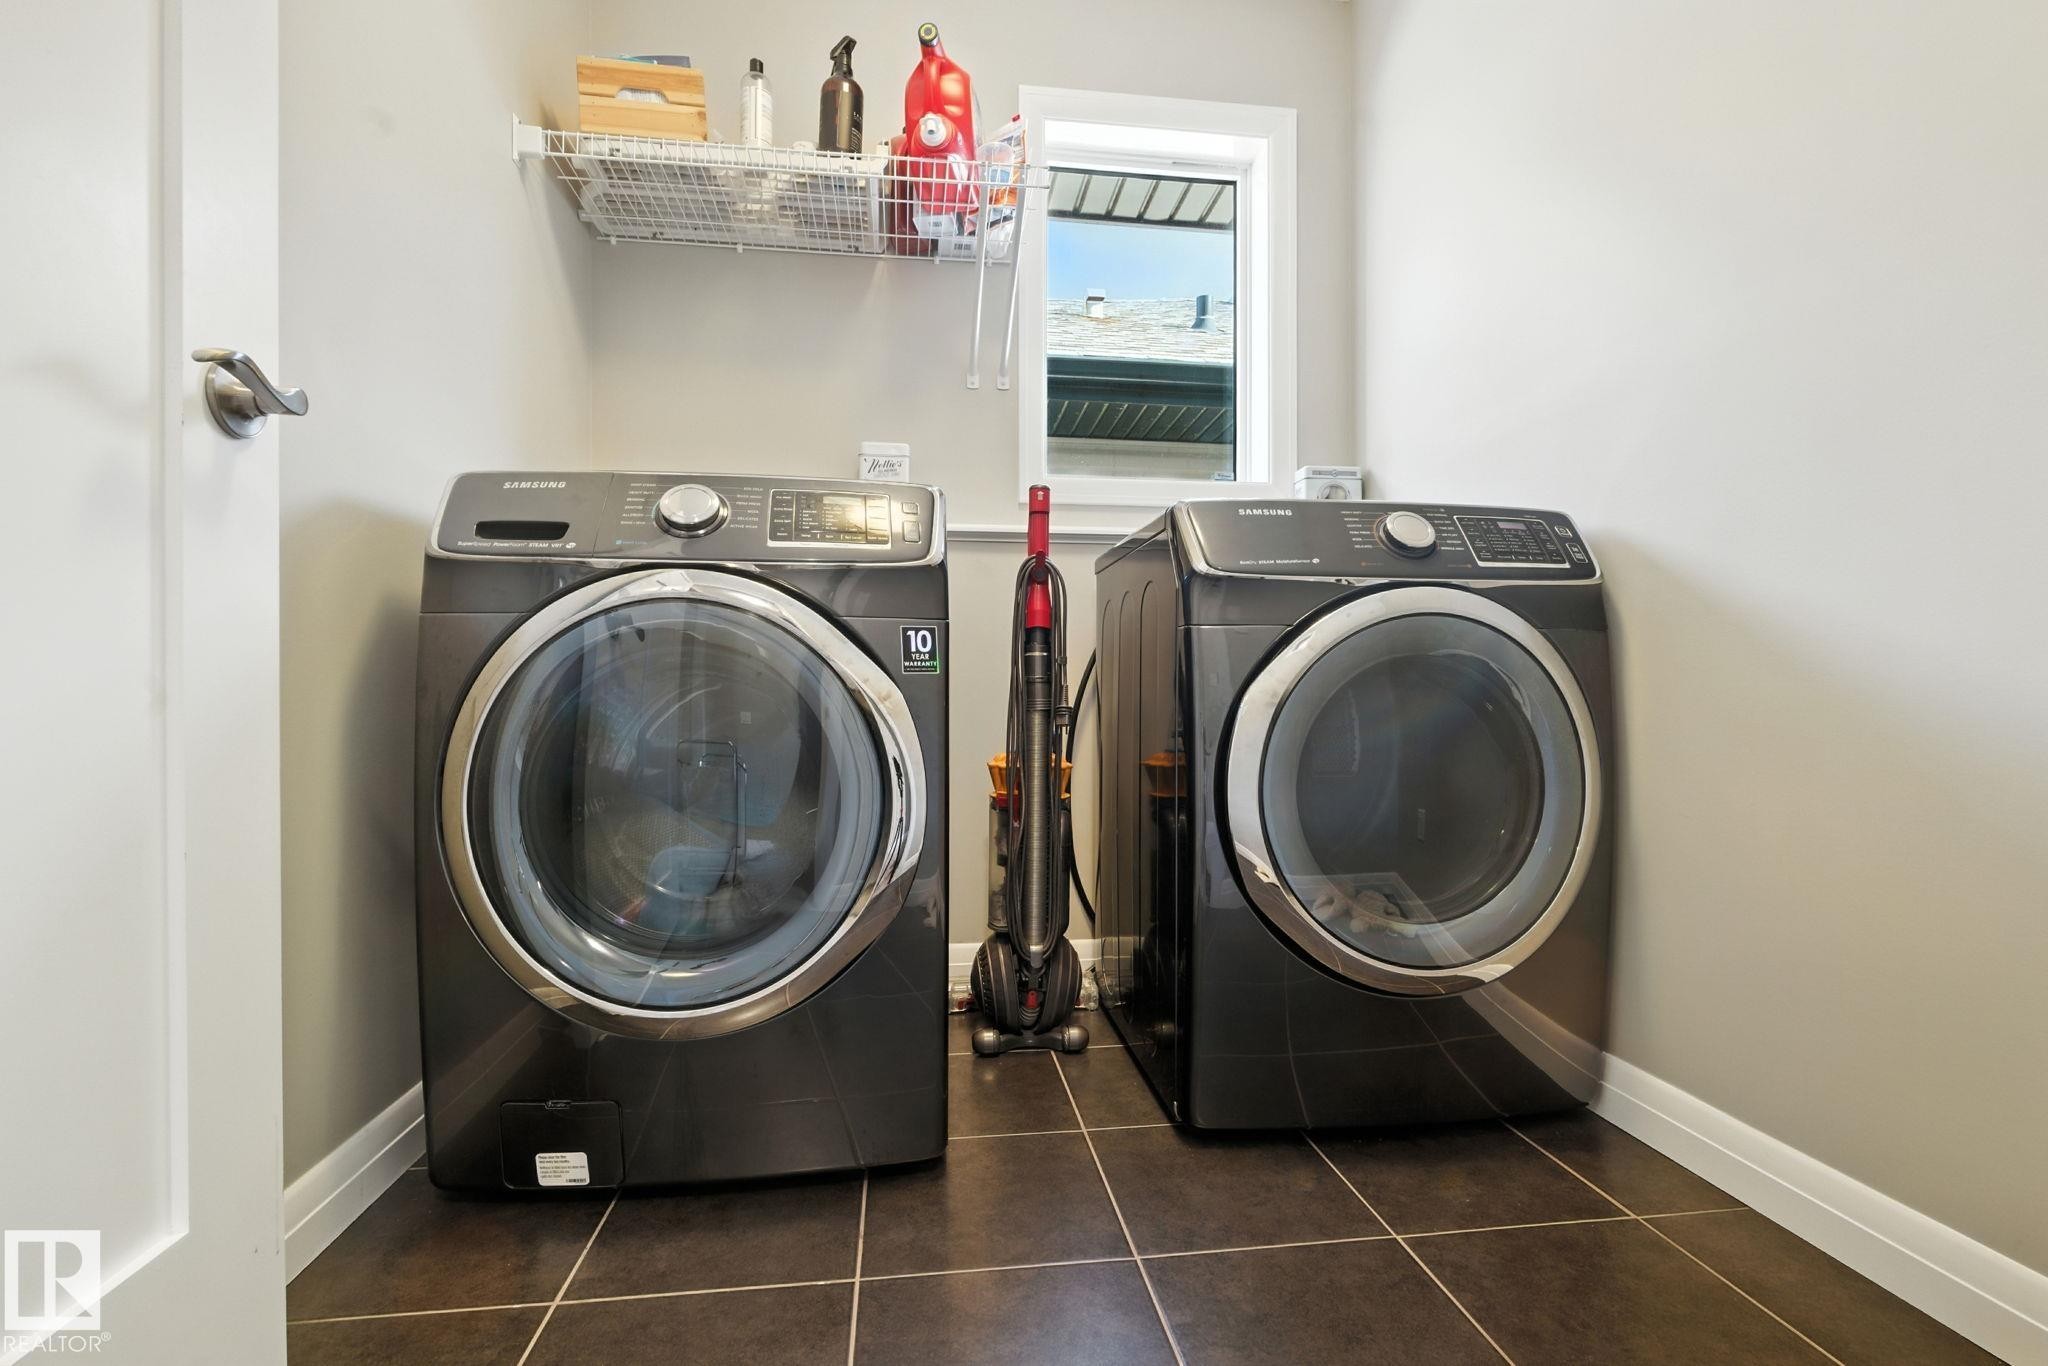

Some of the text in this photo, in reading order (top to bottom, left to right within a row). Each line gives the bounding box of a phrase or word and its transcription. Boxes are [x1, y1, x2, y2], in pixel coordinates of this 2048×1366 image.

[503, 481, 566, 489] SAMSUNG
[1238, 508, 1293, 516] SAMSUNG
[906, 630, 932, 653] 10
